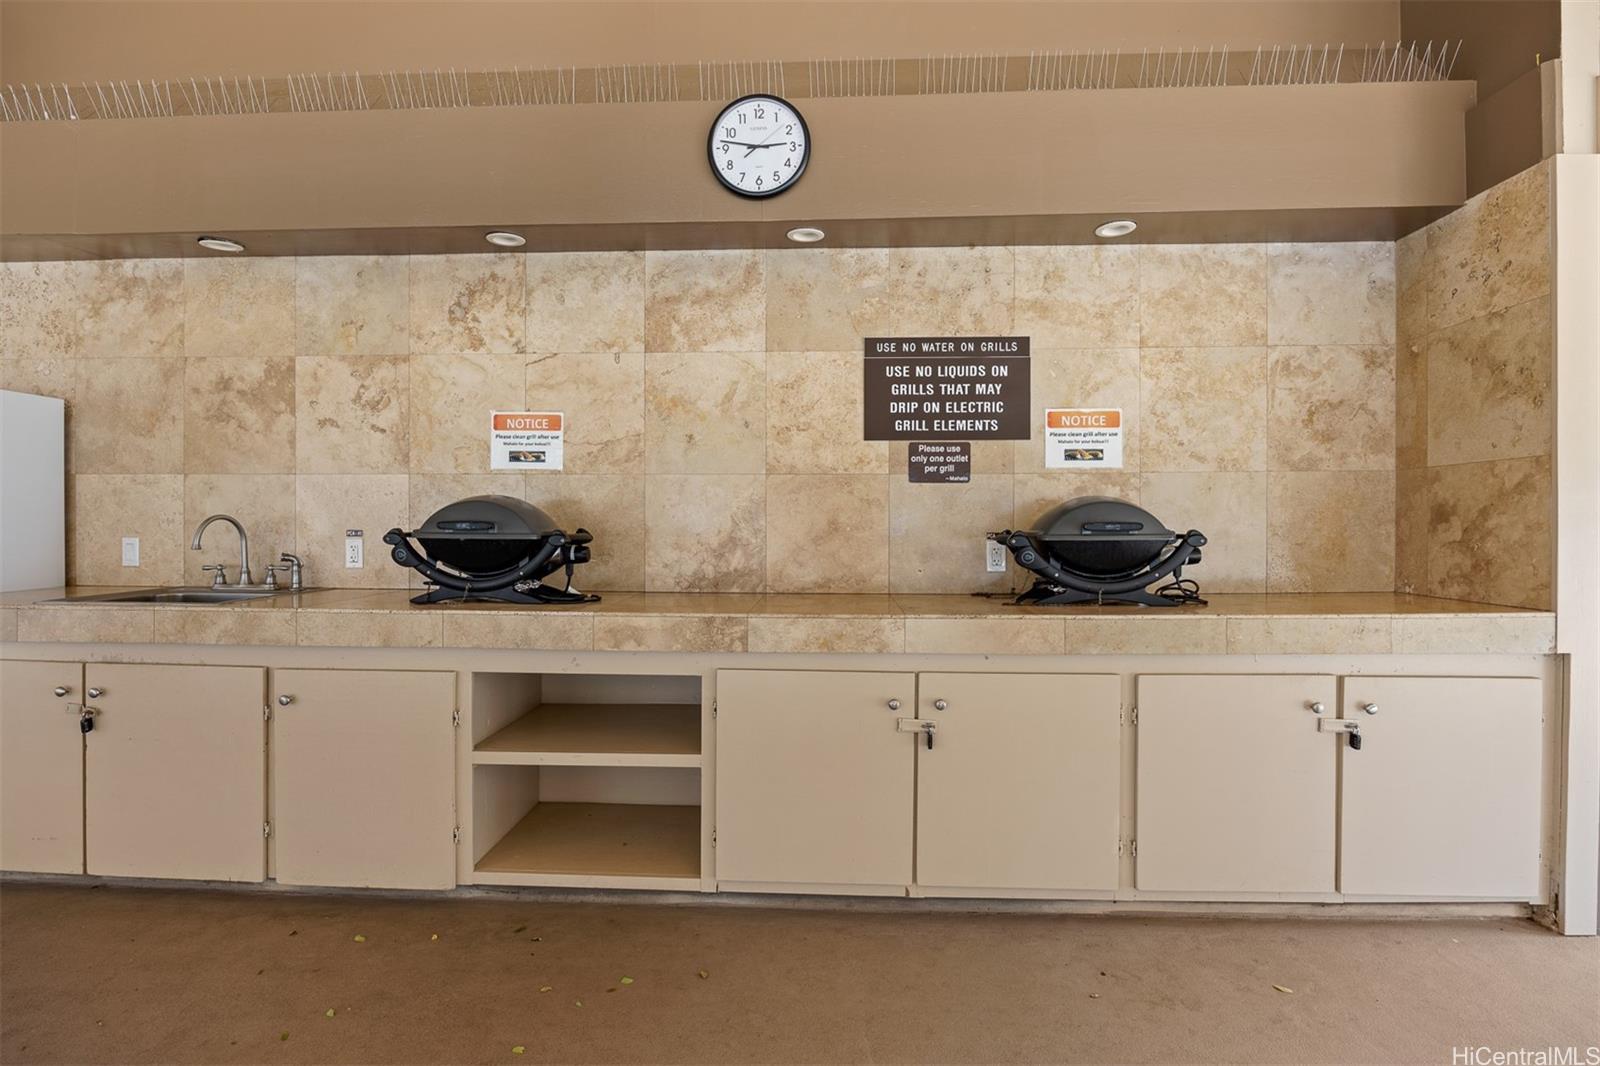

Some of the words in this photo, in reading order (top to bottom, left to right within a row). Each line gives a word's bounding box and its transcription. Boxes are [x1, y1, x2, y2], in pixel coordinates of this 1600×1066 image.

[738, 113, 747, 124] 11
[754, 109, 764, 119] 12
[774, 111, 779, 123] 1
[726, 128, 736, 138] 10
[786, 125, 792, 135] 2
[722, 145, 729, 154] 9
[790, 141, 796, 152] 3
[727, 160, 733, 170] 8
[784, 158, 791, 167] 4
[739, 172, 746, 183] 7
[756, 176, 762, 185] 6
[773, 171, 780, 181] 5
[877, 343, 896, 352] USE
[903, 343, 916, 352] NO
[922, 343, 954, 352] WATER
[961, 343, 973, 351] ON
[981, 342, 1017, 351] GRILLS
[886, 366, 909, 377] USE
[916, 366, 932, 377] NO
[938, 365, 985, 378] LIQUIDS
[992, 366, 1007, 376] ON
[892, 384, 934, 395] GRILLS
[940, 384, 970, 394] THAT
[976, 384, 1001, 394] MAY
[891, 402, 918, 413] DRIP
[924, 402, 939, 413] ON
[946, 402, 1003, 413] ELECTRIC
[507, 418, 550, 429] NOTICE
[895, 420, 928, 431] GRILL
[934, 420, 998, 431] ELEMENTS
[1061, 416, 1107, 426] NOTICE
[911, 455, 928, 464] only
[939, 465, 954, 473] grill
